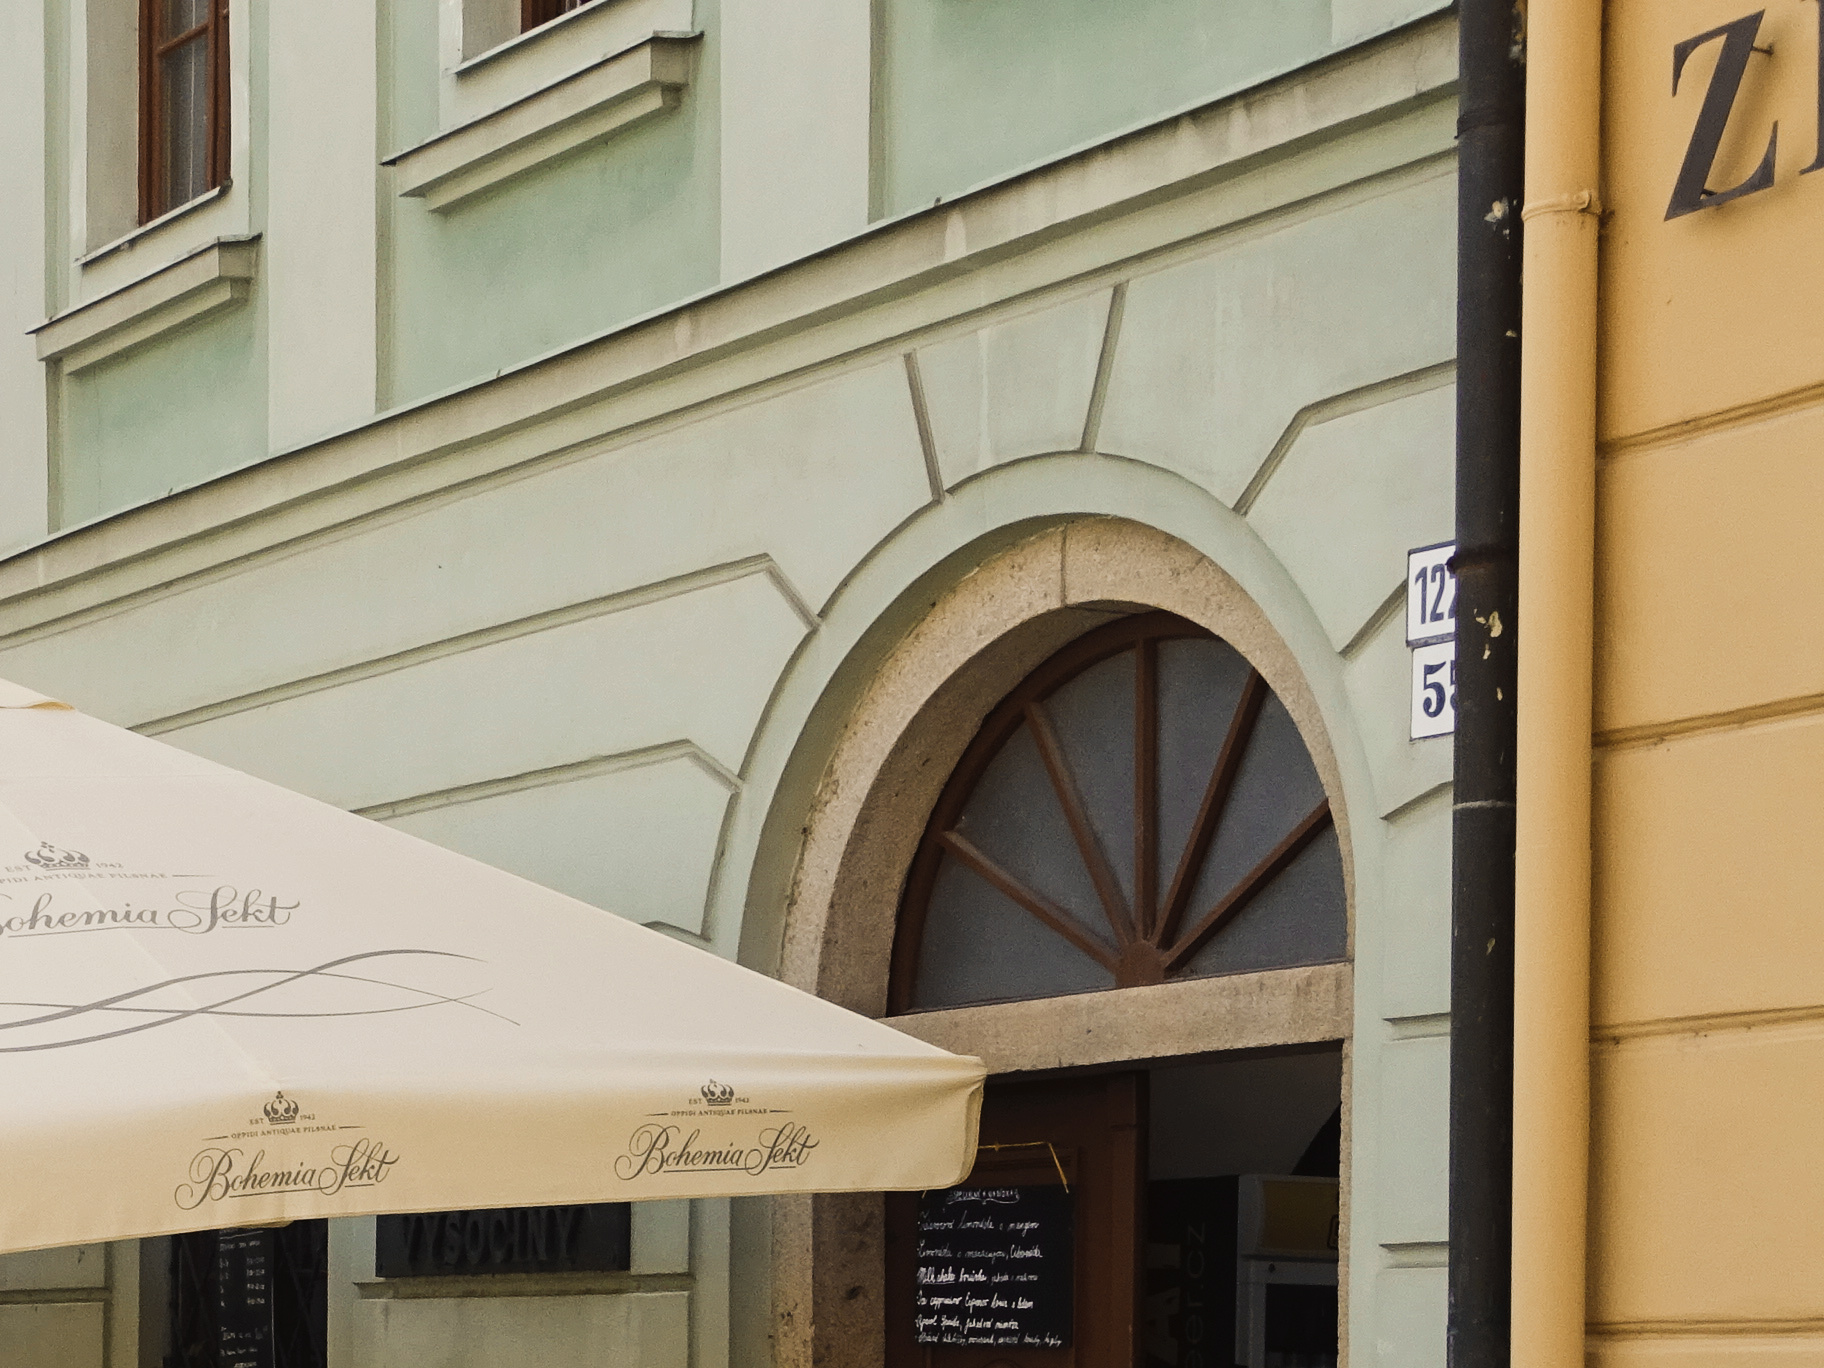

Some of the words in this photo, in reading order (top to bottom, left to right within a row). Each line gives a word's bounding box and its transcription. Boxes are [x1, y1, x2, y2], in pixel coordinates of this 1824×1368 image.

[1664, 0, 1824, 222] Z
[5, 864, 31, 873] EST
[167, 885, 301, 934] Sekt
[174, 1147, 315, 1210] Bohemia
[318, 1138, 400, 1195] Sekt
[614, 1123, 744, 1181] Bohemia
[745, 1121, 820, 1177] Sekt
